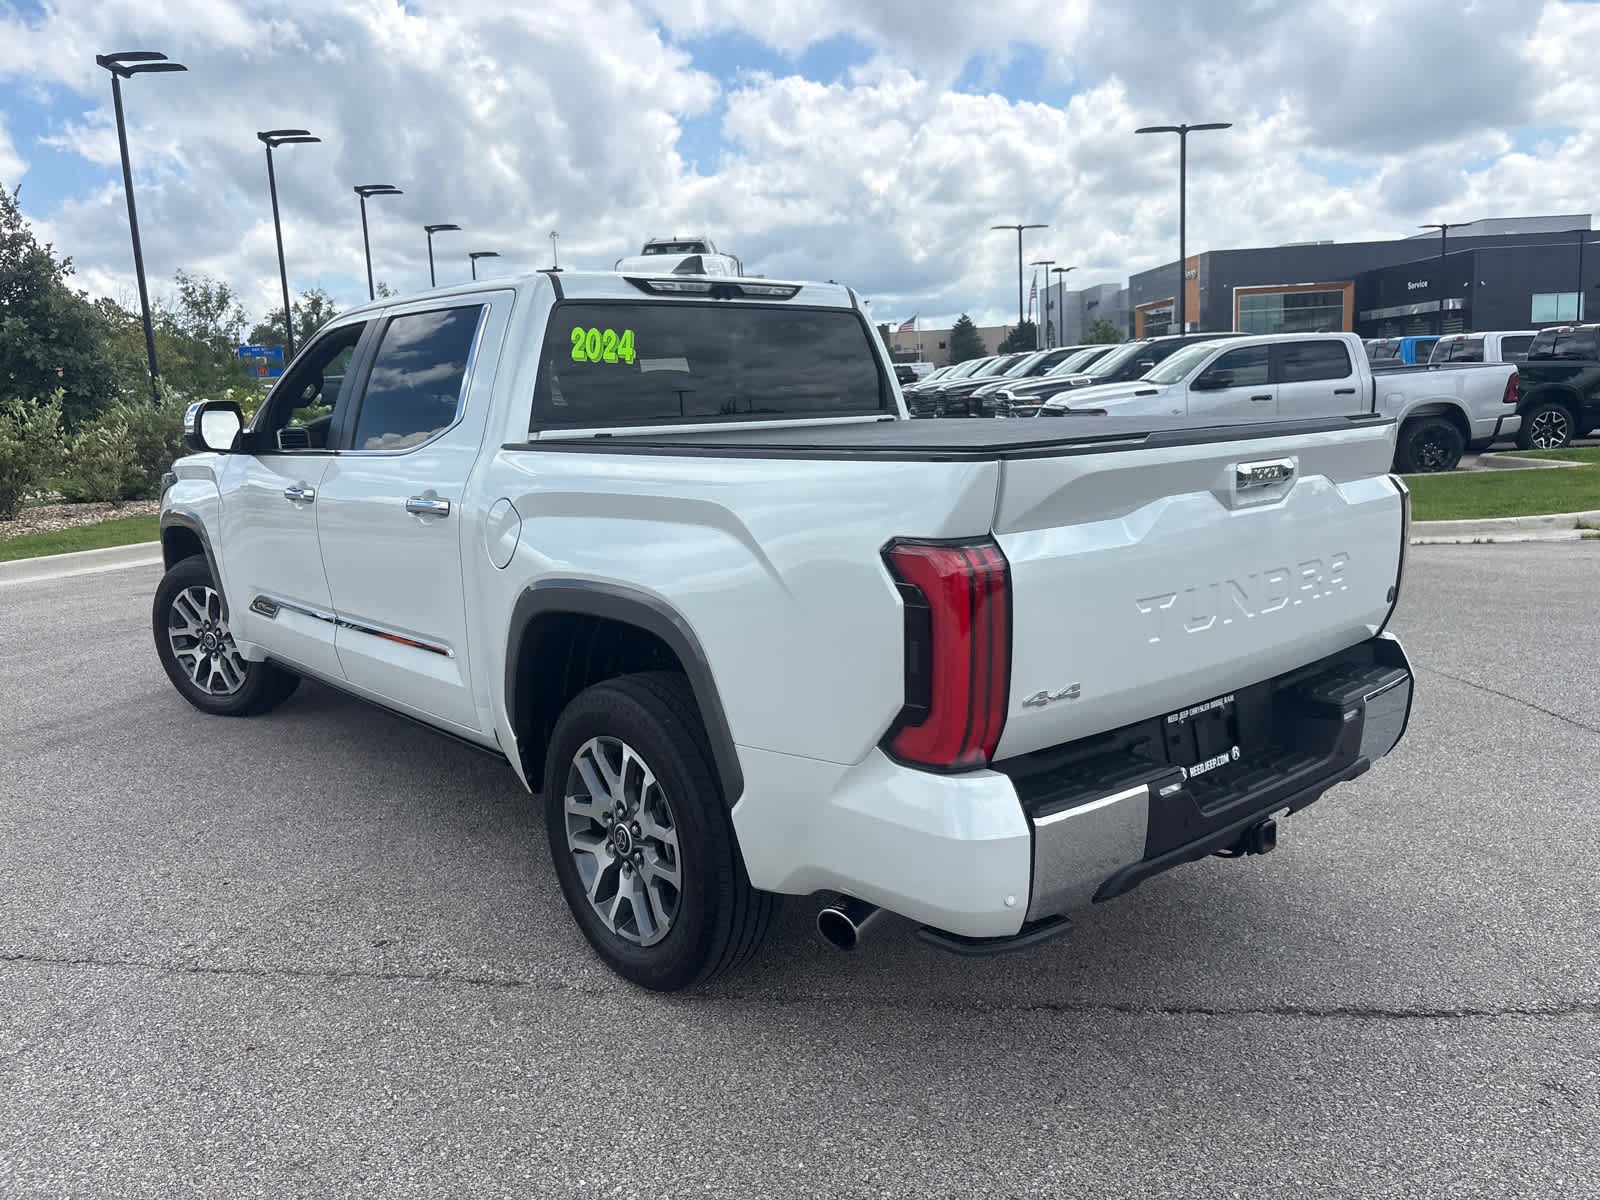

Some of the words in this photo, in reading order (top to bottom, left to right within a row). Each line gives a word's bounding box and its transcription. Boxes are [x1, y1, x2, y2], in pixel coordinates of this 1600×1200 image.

[1407, 279, 1428, 290] Service
[571, 326, 636, 365] 2024
[1136, 551, 1350, 643] TUNDRA
[1168, 713, 1179, 724] REED
[1179, 710, 1189, 720] JEEP
[1189, 703, 1210, 716] CHRYSLER
[1189, 753, 1230, 778] REEDJEEP.COM
